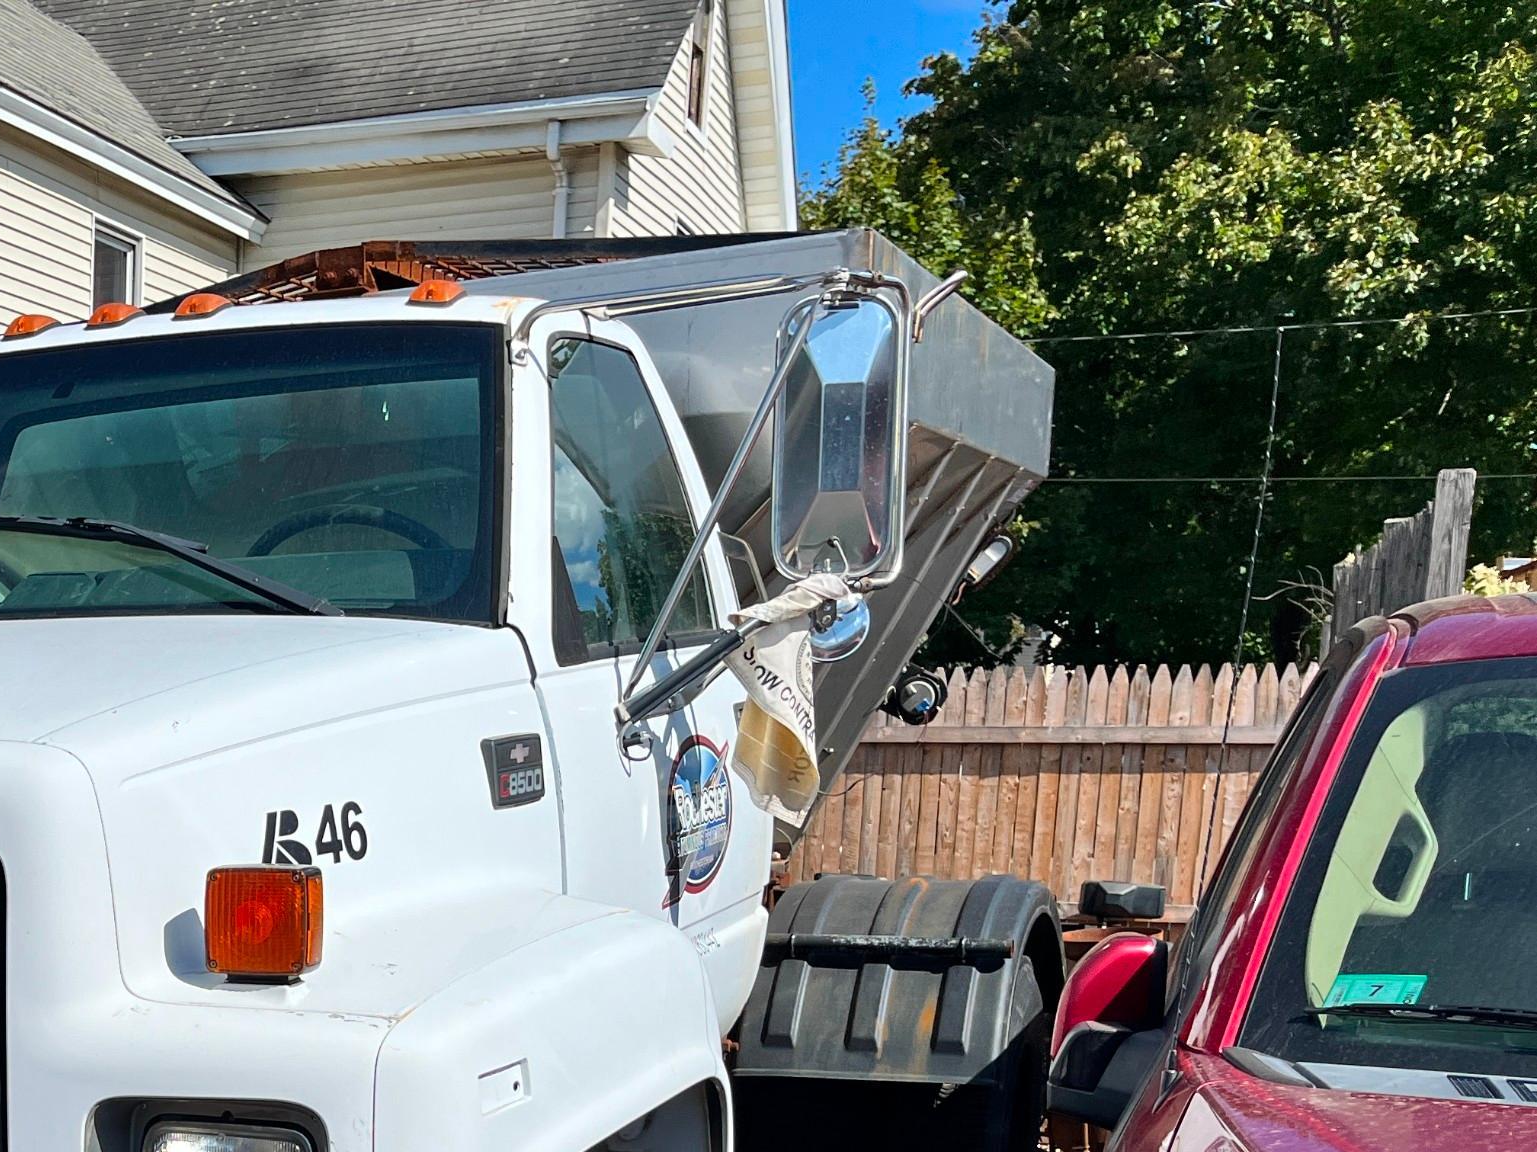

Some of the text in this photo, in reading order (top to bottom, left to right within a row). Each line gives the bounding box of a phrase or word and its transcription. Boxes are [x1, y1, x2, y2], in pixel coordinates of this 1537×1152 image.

[499, 768, 543, 798] C8500
[315, 800, 368, 864] 46
[1368, 984, 1384, 997] 7
